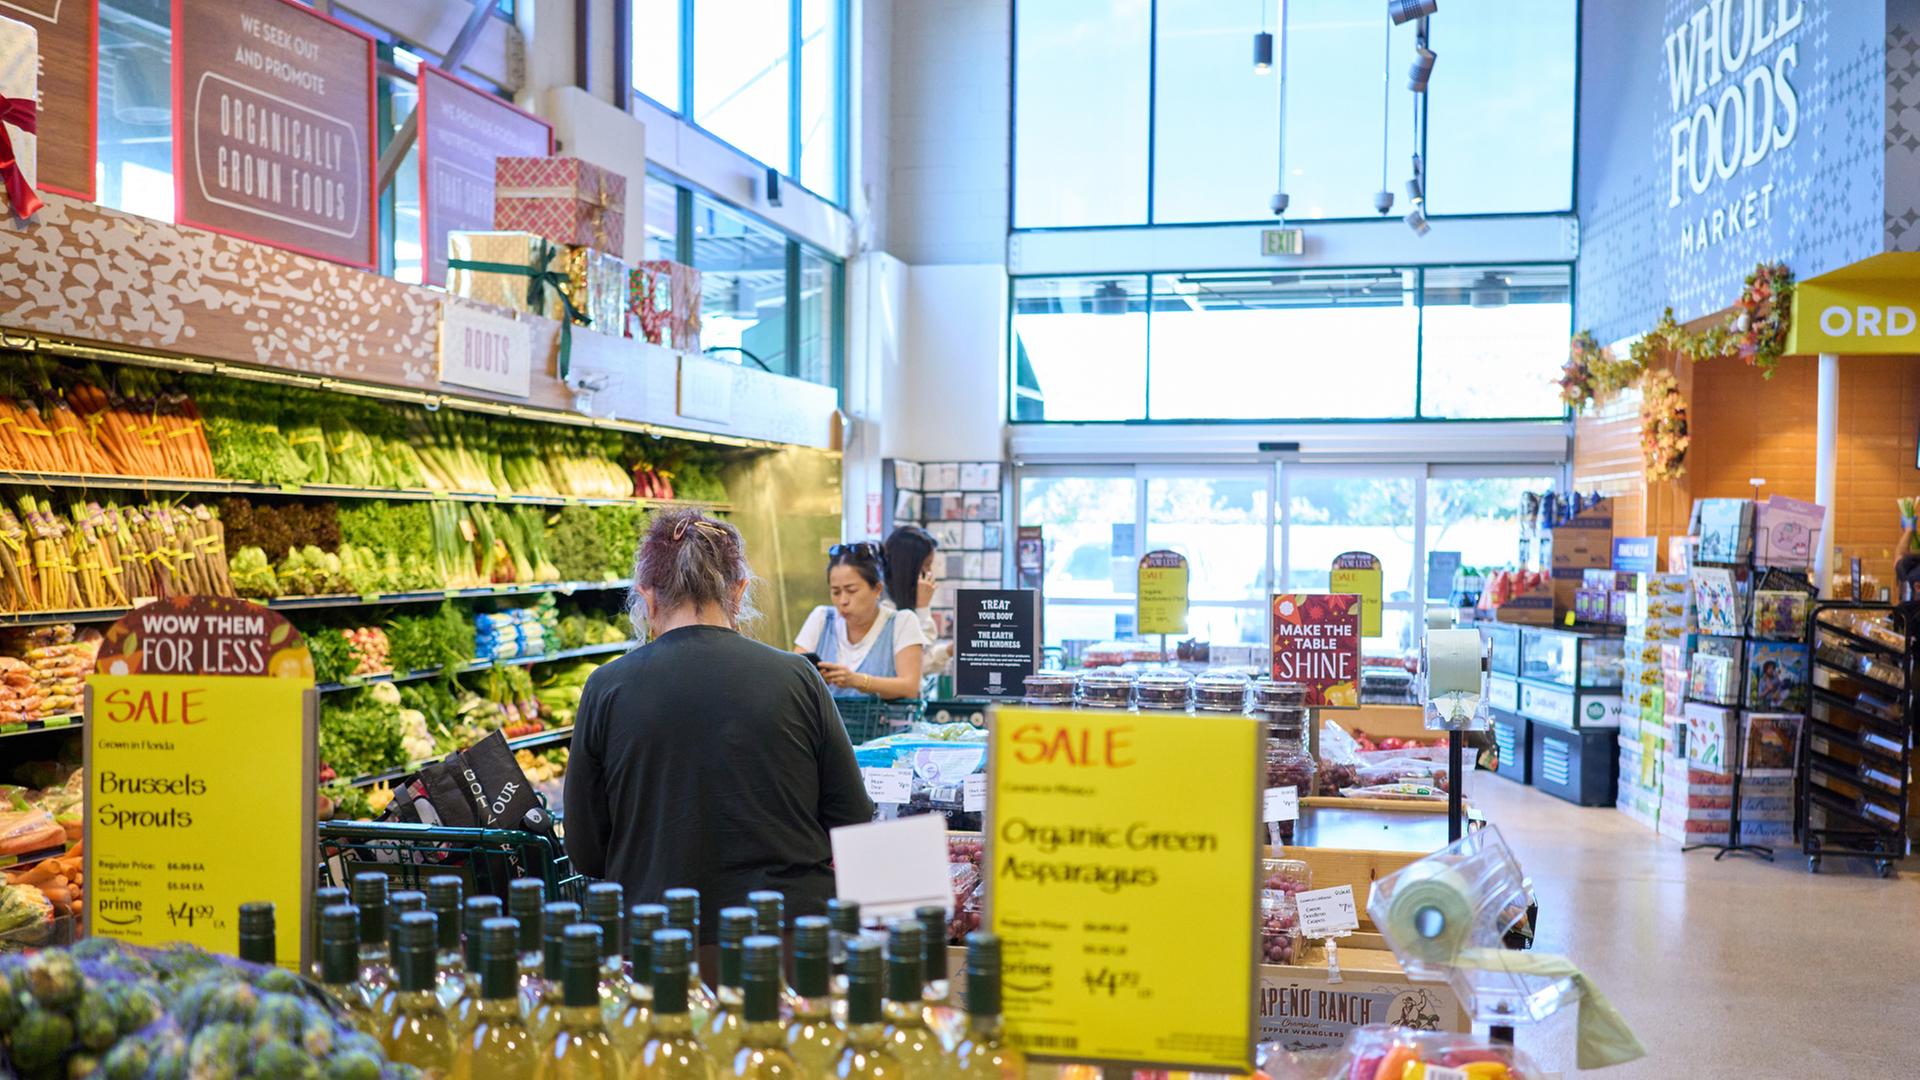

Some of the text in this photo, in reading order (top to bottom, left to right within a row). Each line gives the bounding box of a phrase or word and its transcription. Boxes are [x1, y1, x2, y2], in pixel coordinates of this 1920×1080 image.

[240, 14, 320, 62] WE SEEK OUT
[235, 46, 326, 96] AND PROMOTE
[220, 94, 342, 172] ORGANICALLY
[1668, 42, 1799, 209] FOODS
[218, 146, 345, 221] GROWN FOODS
[1681, 182, 1774, 260] MARKET
[1268, 232, 1296, 253] EXIT
[1819, 305, 1917, 337] ORD
[464, 327, 510, 375] ROOTS
[978, 612, 1014, 620] YOUR BODY
[981, 599, 1011, 610] TREAT
[142, 615, 264, 635] WOW THEM
[978, 631, 1014, 640] THE EARTH
[1280, 624, 1352, 636] MAKE THE
[142, 637, 265, 673] FOR LESS
[971, 640, 1021, 649] WITH KINDNESS
[1294, 638, 1337, 650] TABLE
[1280, 651, 1352, 679] SHINE
[105, 688, 209, 725] SALE
[1011, 724, 1137, 769] SALE
[99, 771, 207, 796] Brussels
[463, 768, 488, 809] GOT
[98, 803, 193, 830] Sprouts
[1001, 817, 1219, 854] Organic Green
[98, 860, 155, 871] Regular Price:
[1000, 856, 1159, 894] Asparagus
[98, 877, 141, 887] Sale Price:
[98, 896, 143, 913] prime
[1319, 990, 1373, 1026] RANCH
[1260, 1026, 1344, 1038] EPPER WRANGLERS
[1281, 1018, 1320, 1028] Champion
